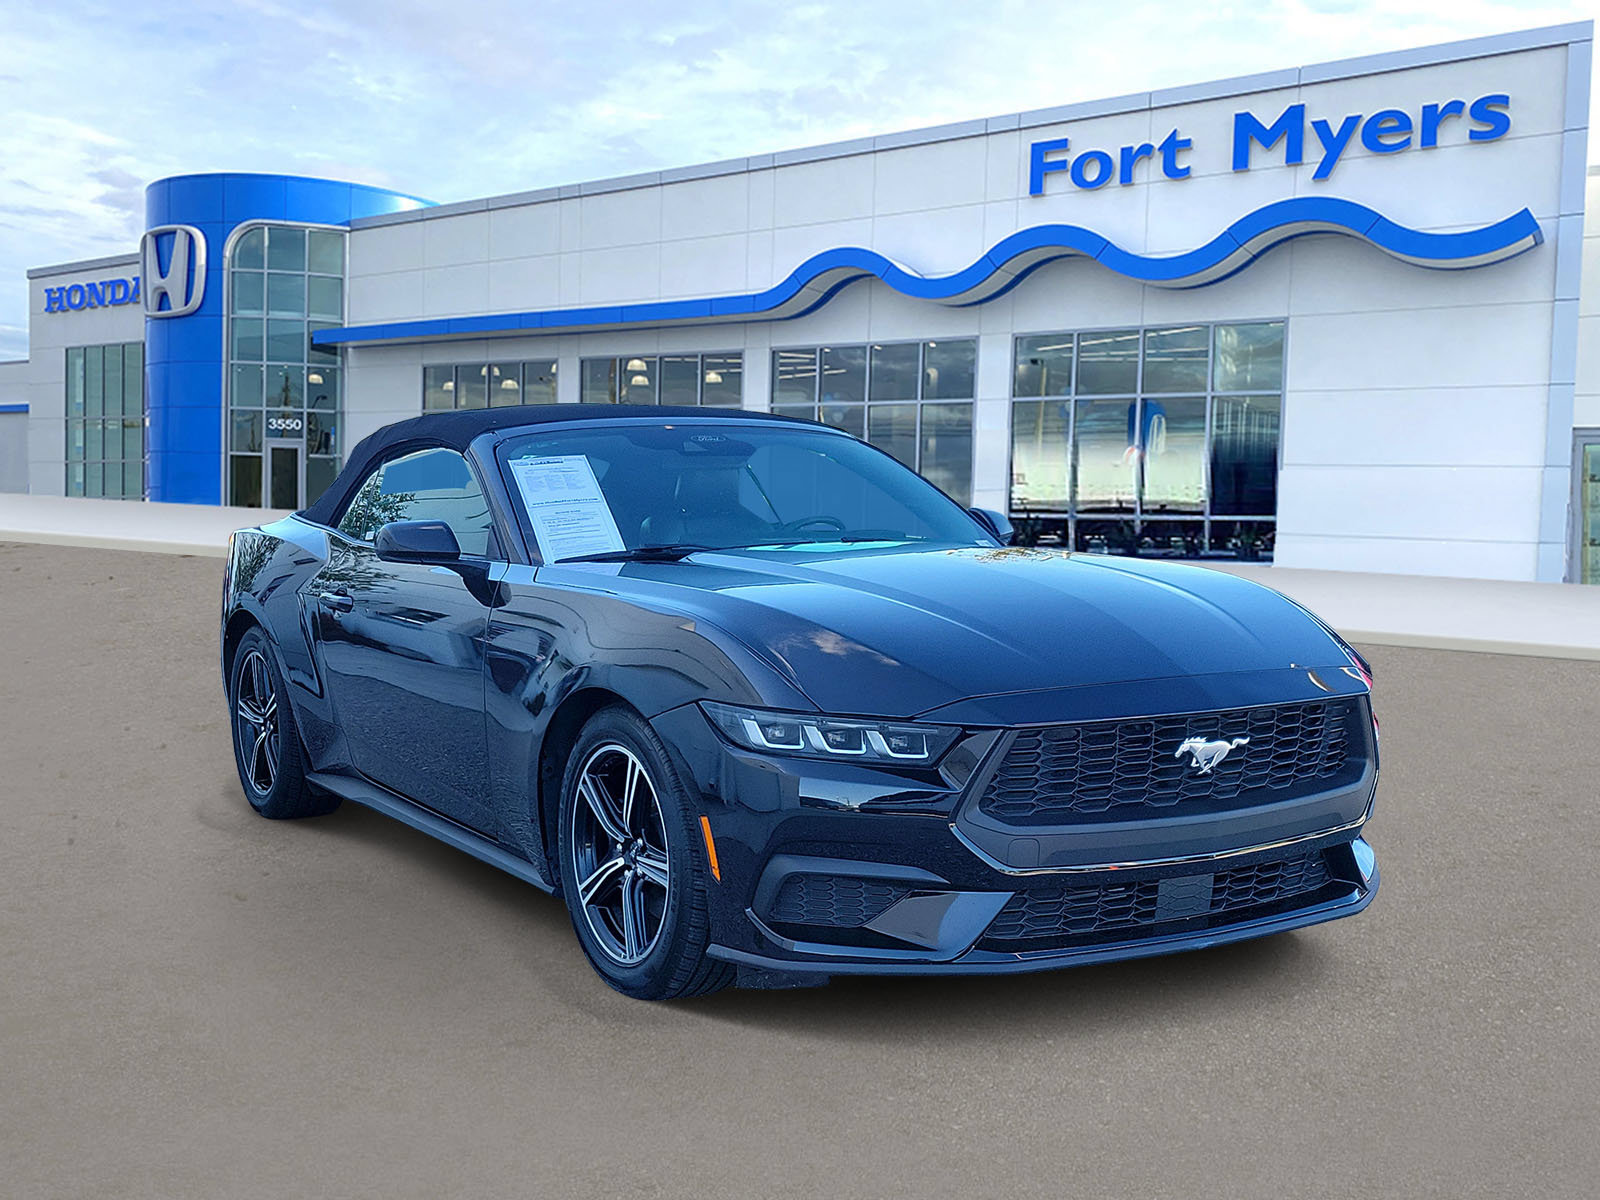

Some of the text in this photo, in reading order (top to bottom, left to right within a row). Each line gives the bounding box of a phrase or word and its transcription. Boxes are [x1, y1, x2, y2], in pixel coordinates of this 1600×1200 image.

[1029, 93, 1511, 196] Fort Myers
[267, 417, 302, 431] 3550
